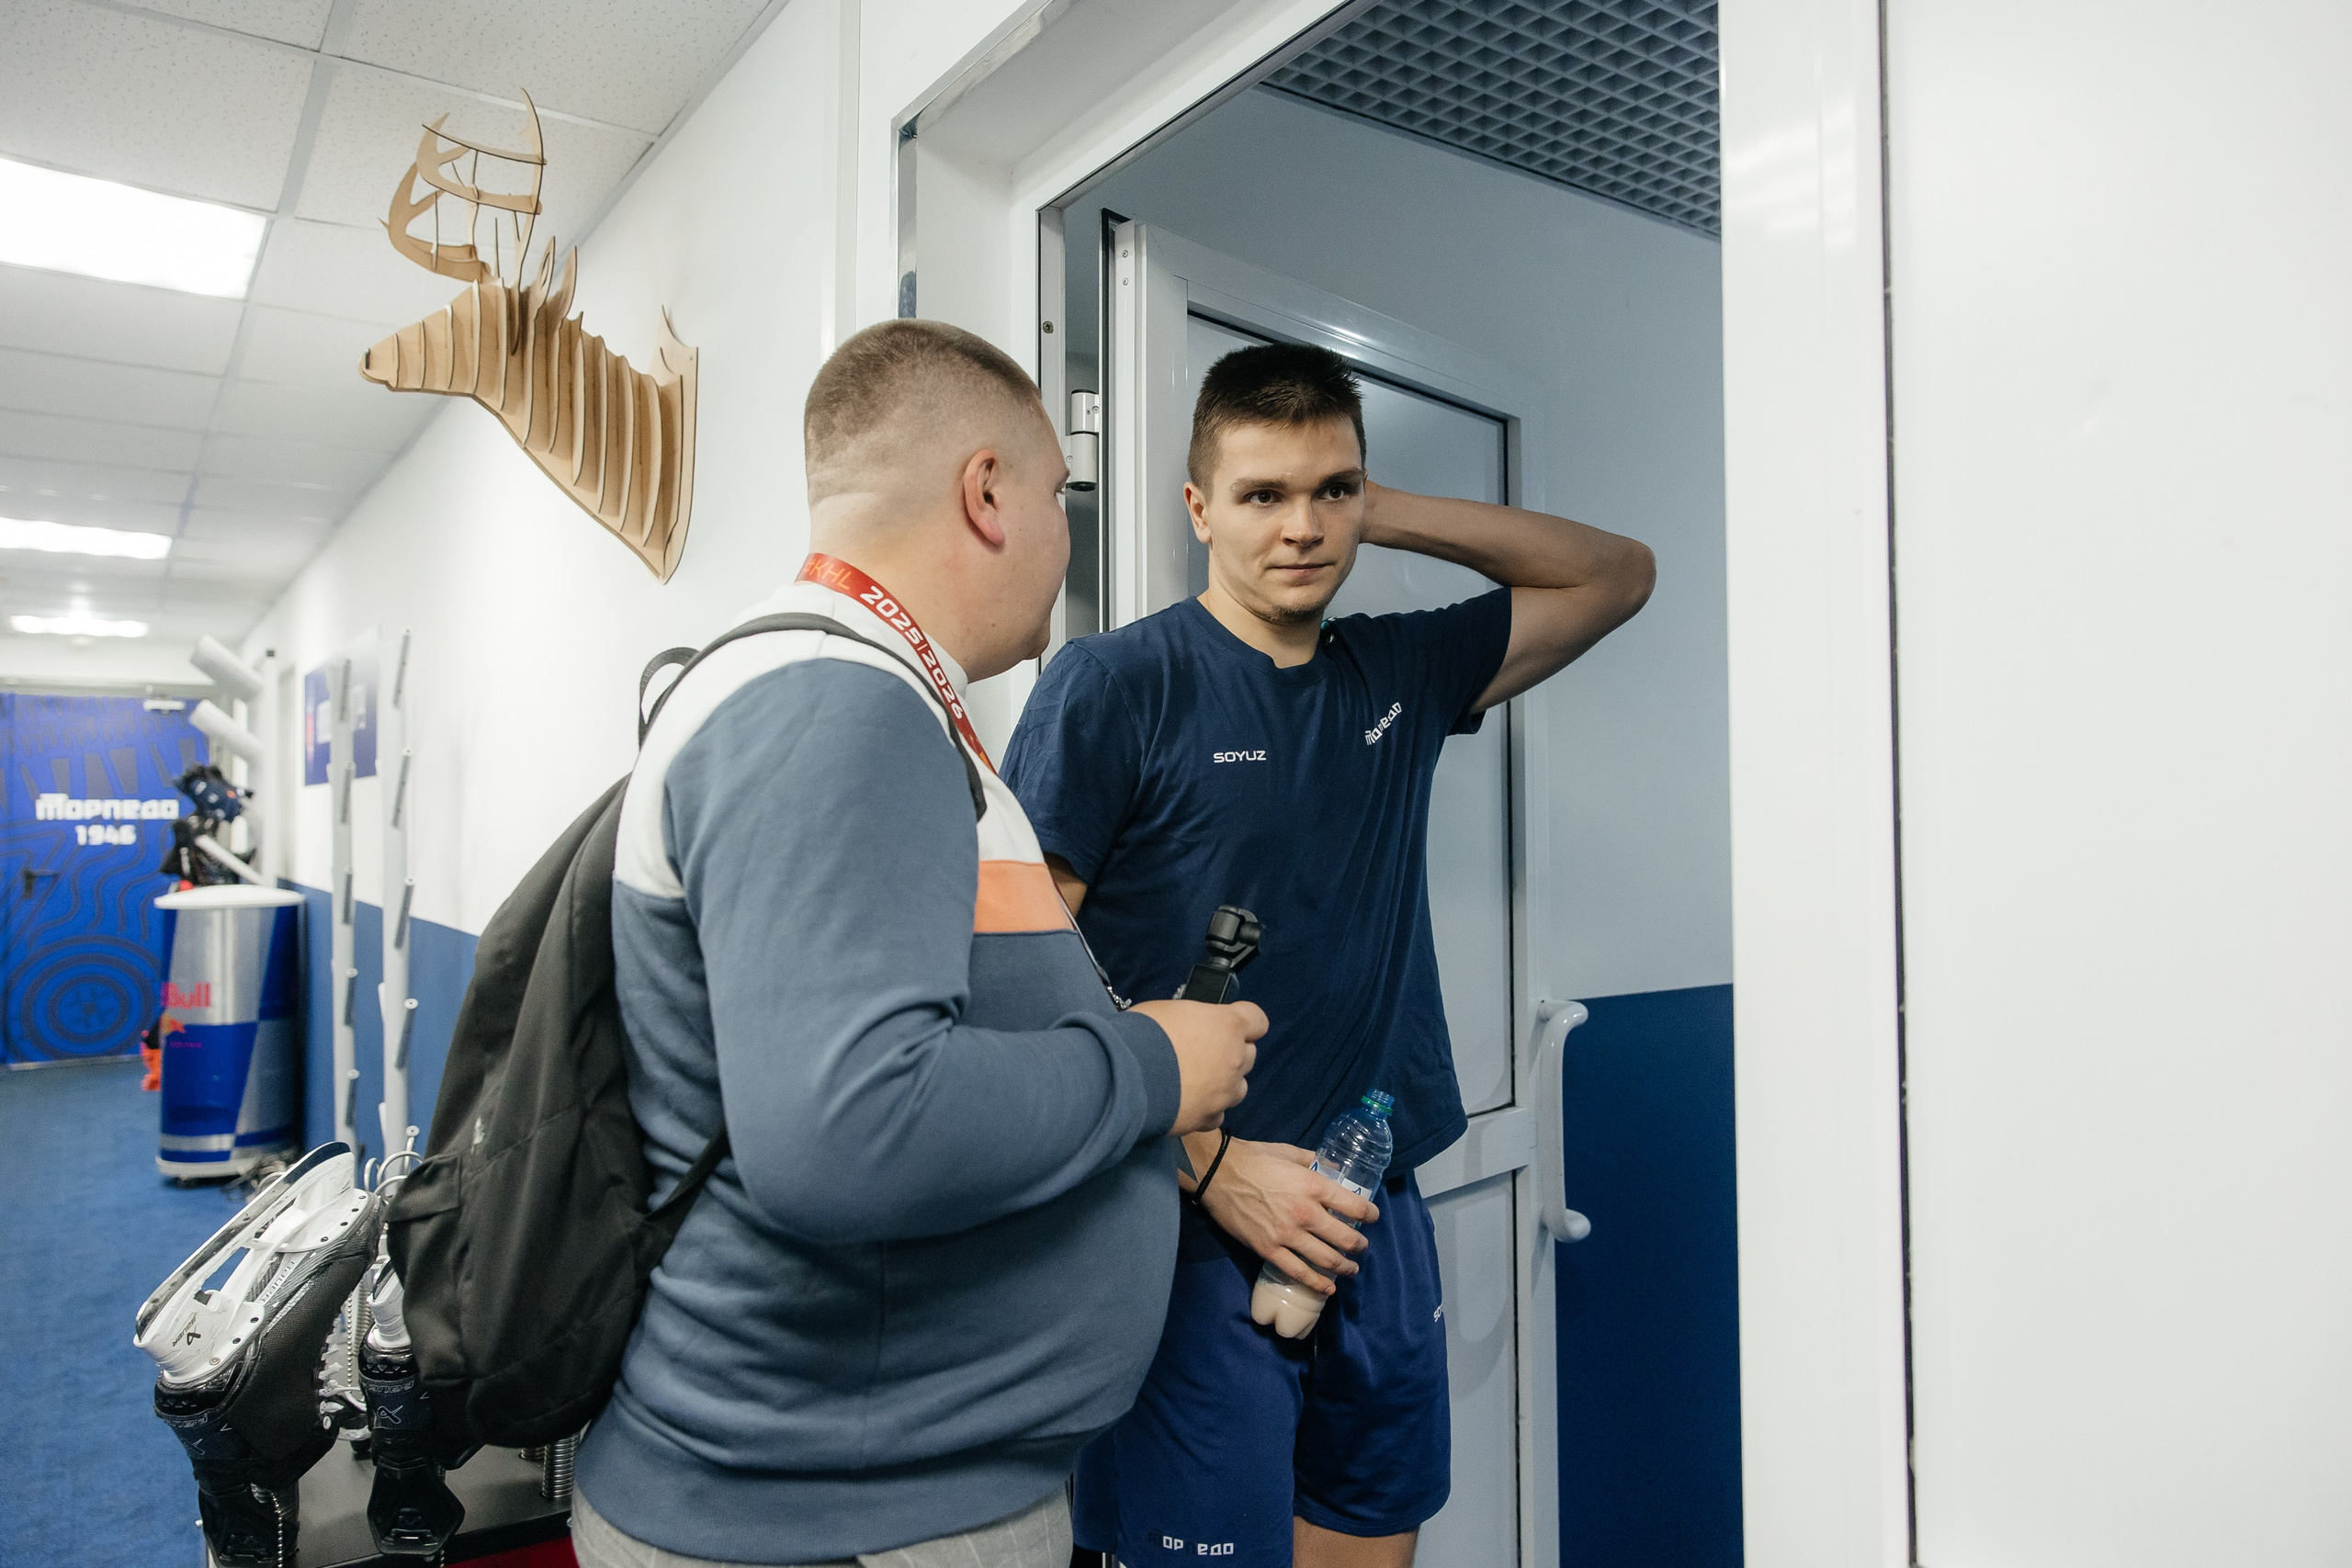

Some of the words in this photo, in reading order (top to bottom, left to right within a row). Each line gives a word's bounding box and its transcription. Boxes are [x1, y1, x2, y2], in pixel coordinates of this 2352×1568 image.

[803, 558, 853, 590] #KHL
[1213, 750, 1267, 763] SOYUZ
[75, 825, 137, 846] 1946
[161, 982, 211, 1010] Bull
